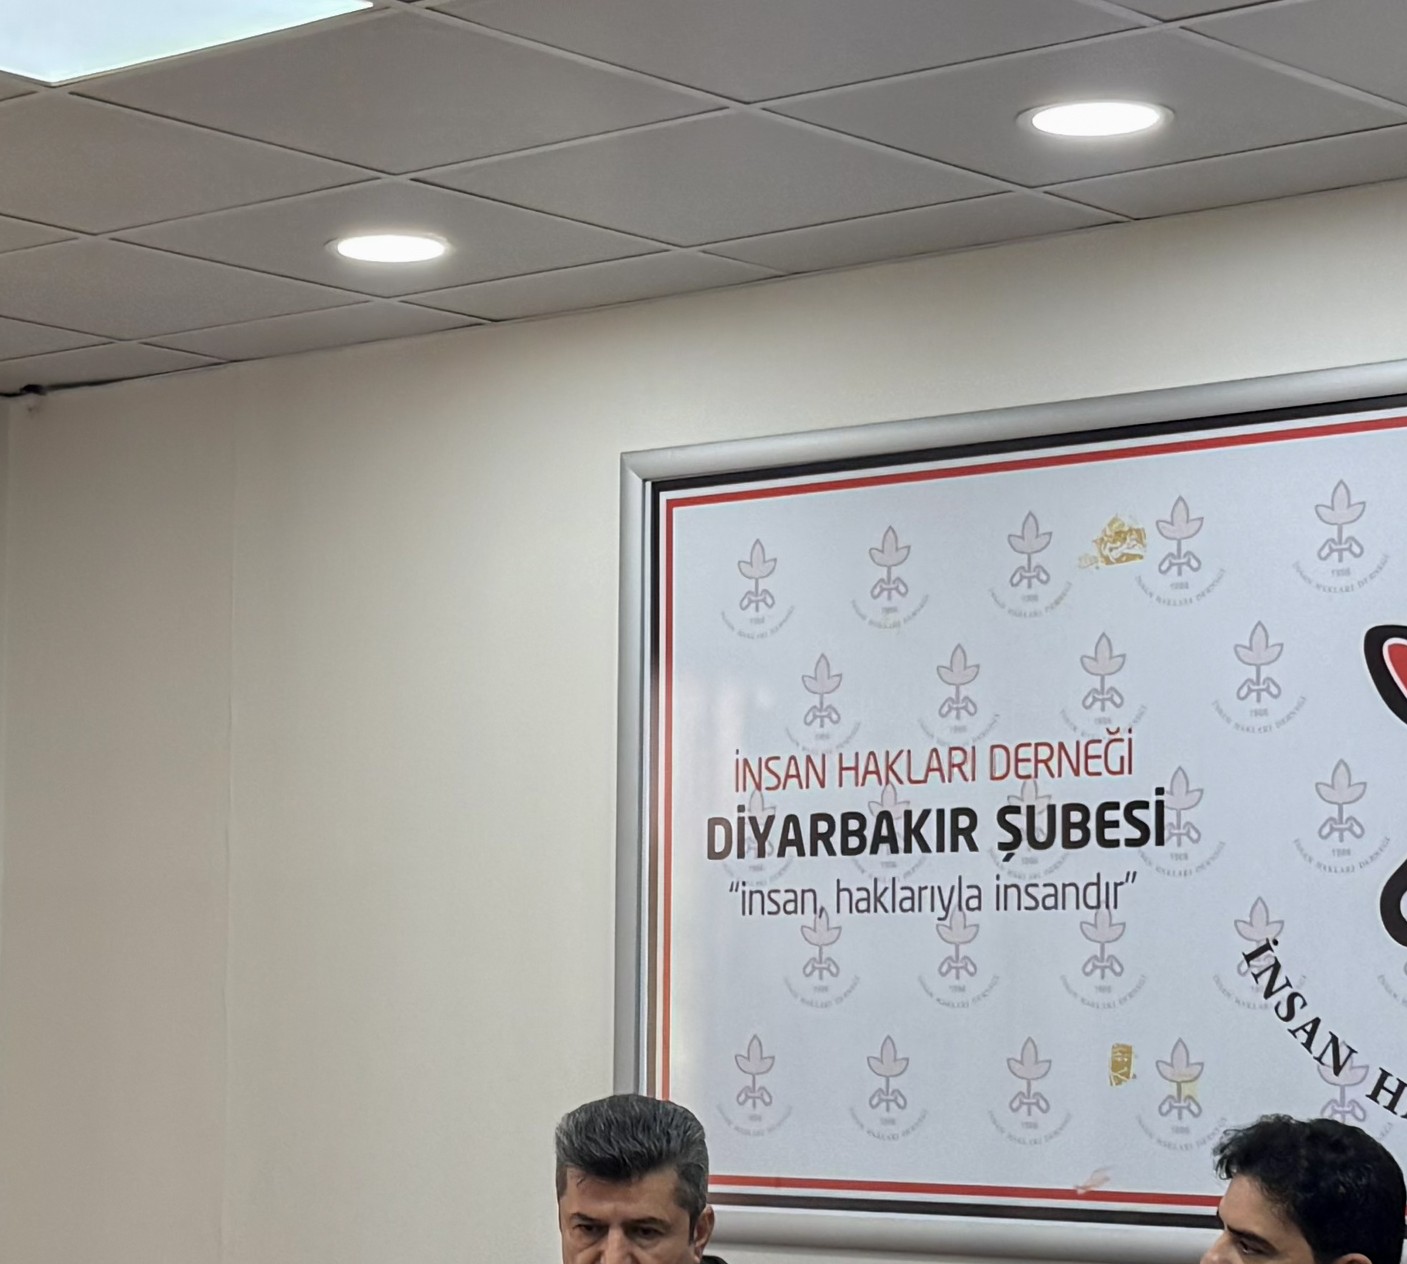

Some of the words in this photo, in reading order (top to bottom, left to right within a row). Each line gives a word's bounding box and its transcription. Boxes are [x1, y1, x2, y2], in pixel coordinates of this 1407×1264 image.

[734, 748, 826, 793] İNSAN
[838, 745, 976, 789] HAKLARI
[989, 727, 1134, 781] DERNEĞİ
[706, 804, 979, 861] DİYARBAKIR
[996, 787, 1165, 862] ŞUBESİ
[835, 875, 983, 921] haklarıyla
[1241, 937, 1359, 1077] İNSAN
